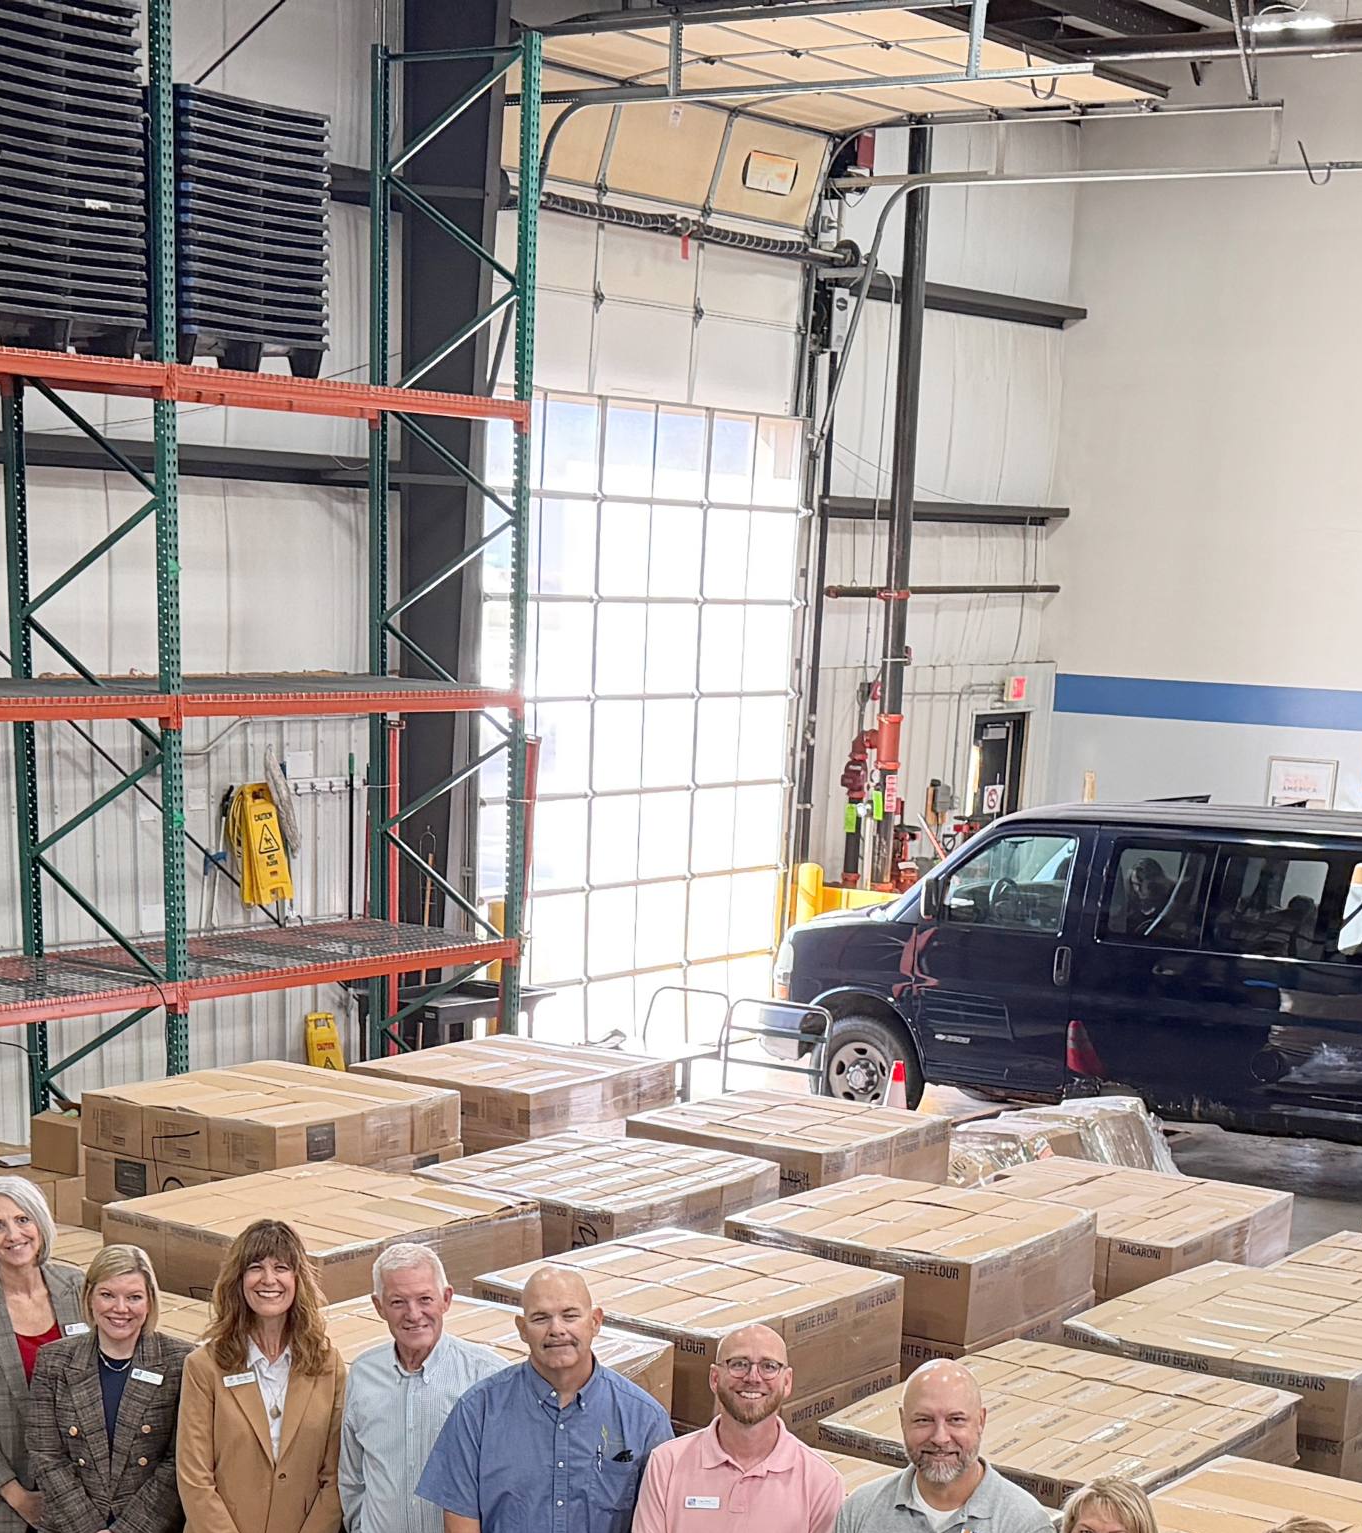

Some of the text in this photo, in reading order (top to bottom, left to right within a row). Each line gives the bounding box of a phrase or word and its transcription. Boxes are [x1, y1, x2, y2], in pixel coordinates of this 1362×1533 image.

[838, 1250, 871, 1268] FLOUR
[1118, 1243, 1161, 1261] MACARONI
[927, 1263, 959, 1281] FLOUR
[855, 1288, 897, 1313] WHITE FLOUR
[795, 1307, 838, 1333] WHITE FLOUR
[1063, 1328, 1087, 1344] PINTO
[674, 1338, 706, 1356] FLOUR
[901, 1343, 922, 1359] HITE
[1139, 1348, 1210, 1372] PINTO BEANS
[851, 1375, 894, 1400] WHITE FLOUR
[1252, 1369, 1326, 1392] PINTO BEANS
[791, 1397, 835, 1423] WHITE FLOUR
